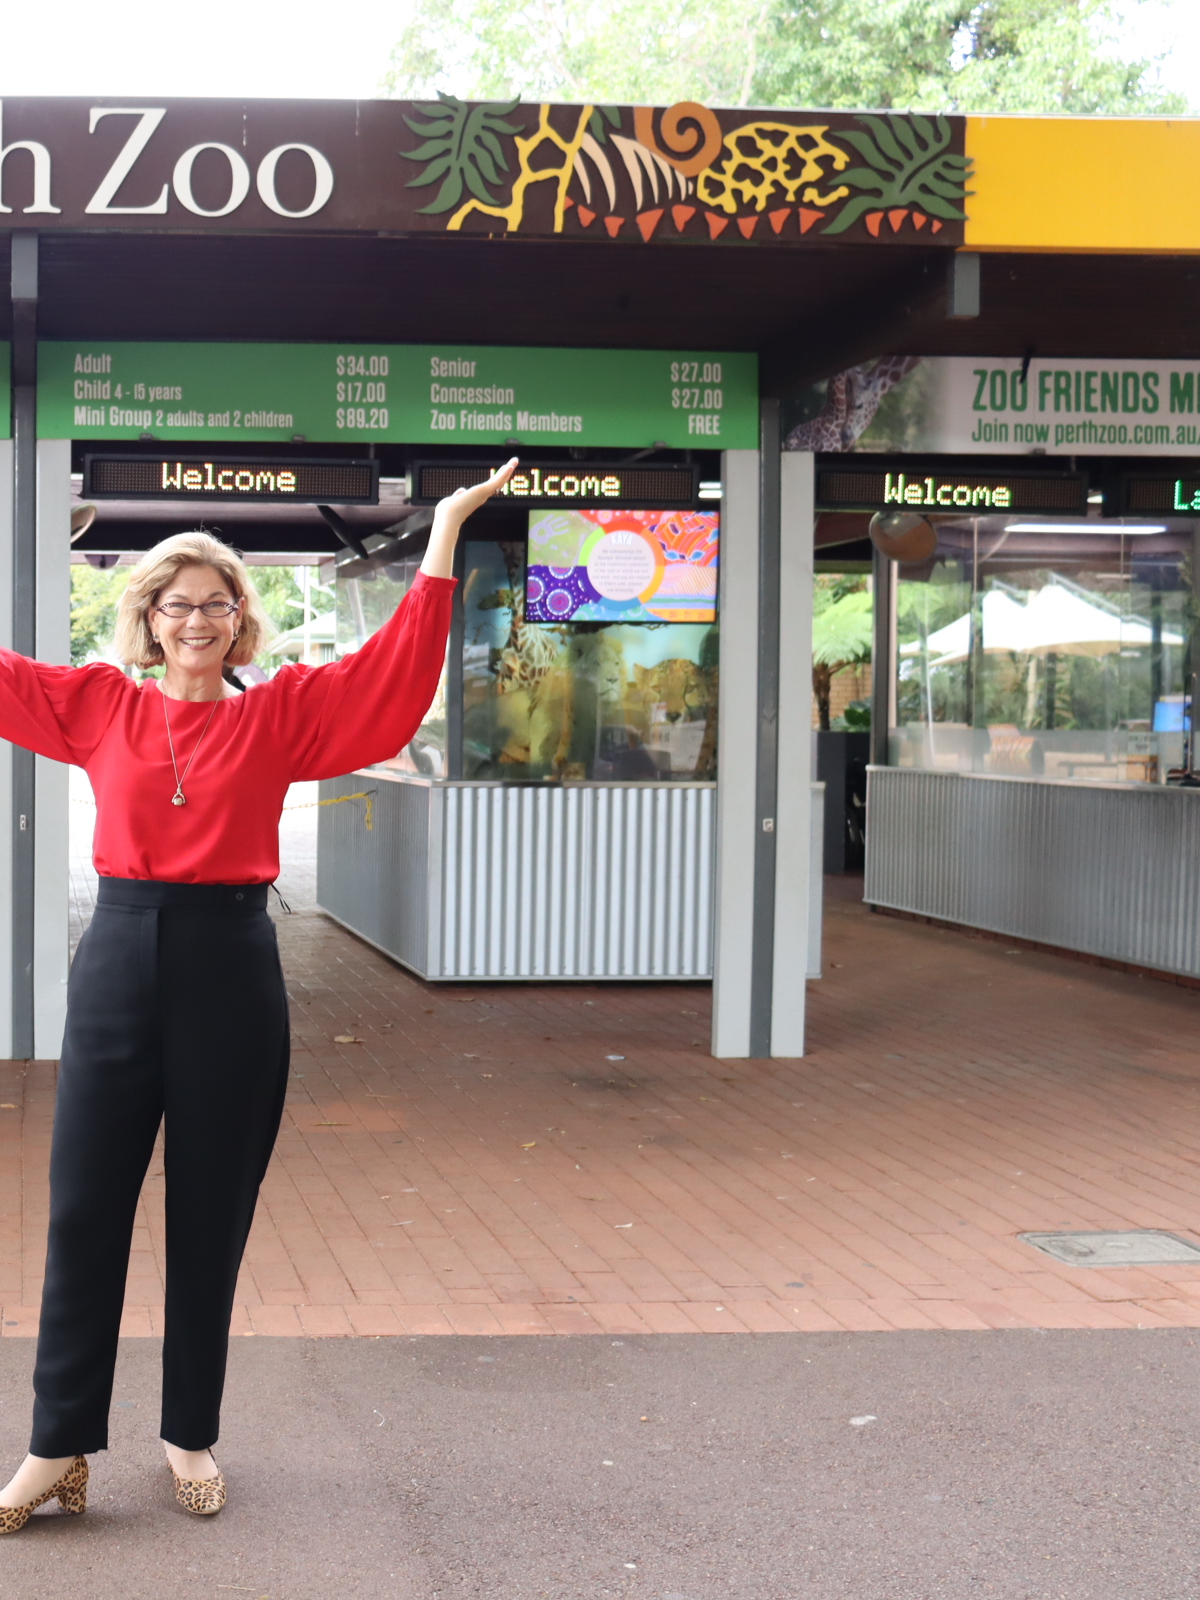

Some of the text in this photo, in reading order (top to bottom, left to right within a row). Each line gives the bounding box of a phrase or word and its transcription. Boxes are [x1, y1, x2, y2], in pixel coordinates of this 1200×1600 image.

[85, 107, 334, 218] Zoo
[74, 353, 389, 377] Adult $34.00
[430, 357, 476, 378] Senior
[74, 380, 111, 401] Child
[114, 385, 123, 399] 4
[134, 384, 146, 399] 15
[149, 385, 182, 403] years
[430, 383, 515, 405] Concession
[972, 369, 1200, 414] ZOO FRIENDS M
[74, 405, 106, 427] Mini
[109, 406, 152, 429] Group
[156, 411, 164, 427] 2
[166, 410, 204, 428] adults
[208, 410, 230, 428] and
[233, 411, 241, 428] 2
[244, 411, 294, 429] children
[430, 410, 720, 436] Zoo Friends Members FREE
[972, 418, 1009, 443] Join
[1014, 422, 1049, 443] now
[161, 462, 297, 492] Welcome
[883, 472, 1012, 507] Welcome
[610, 532, 633, 546] KAYA
